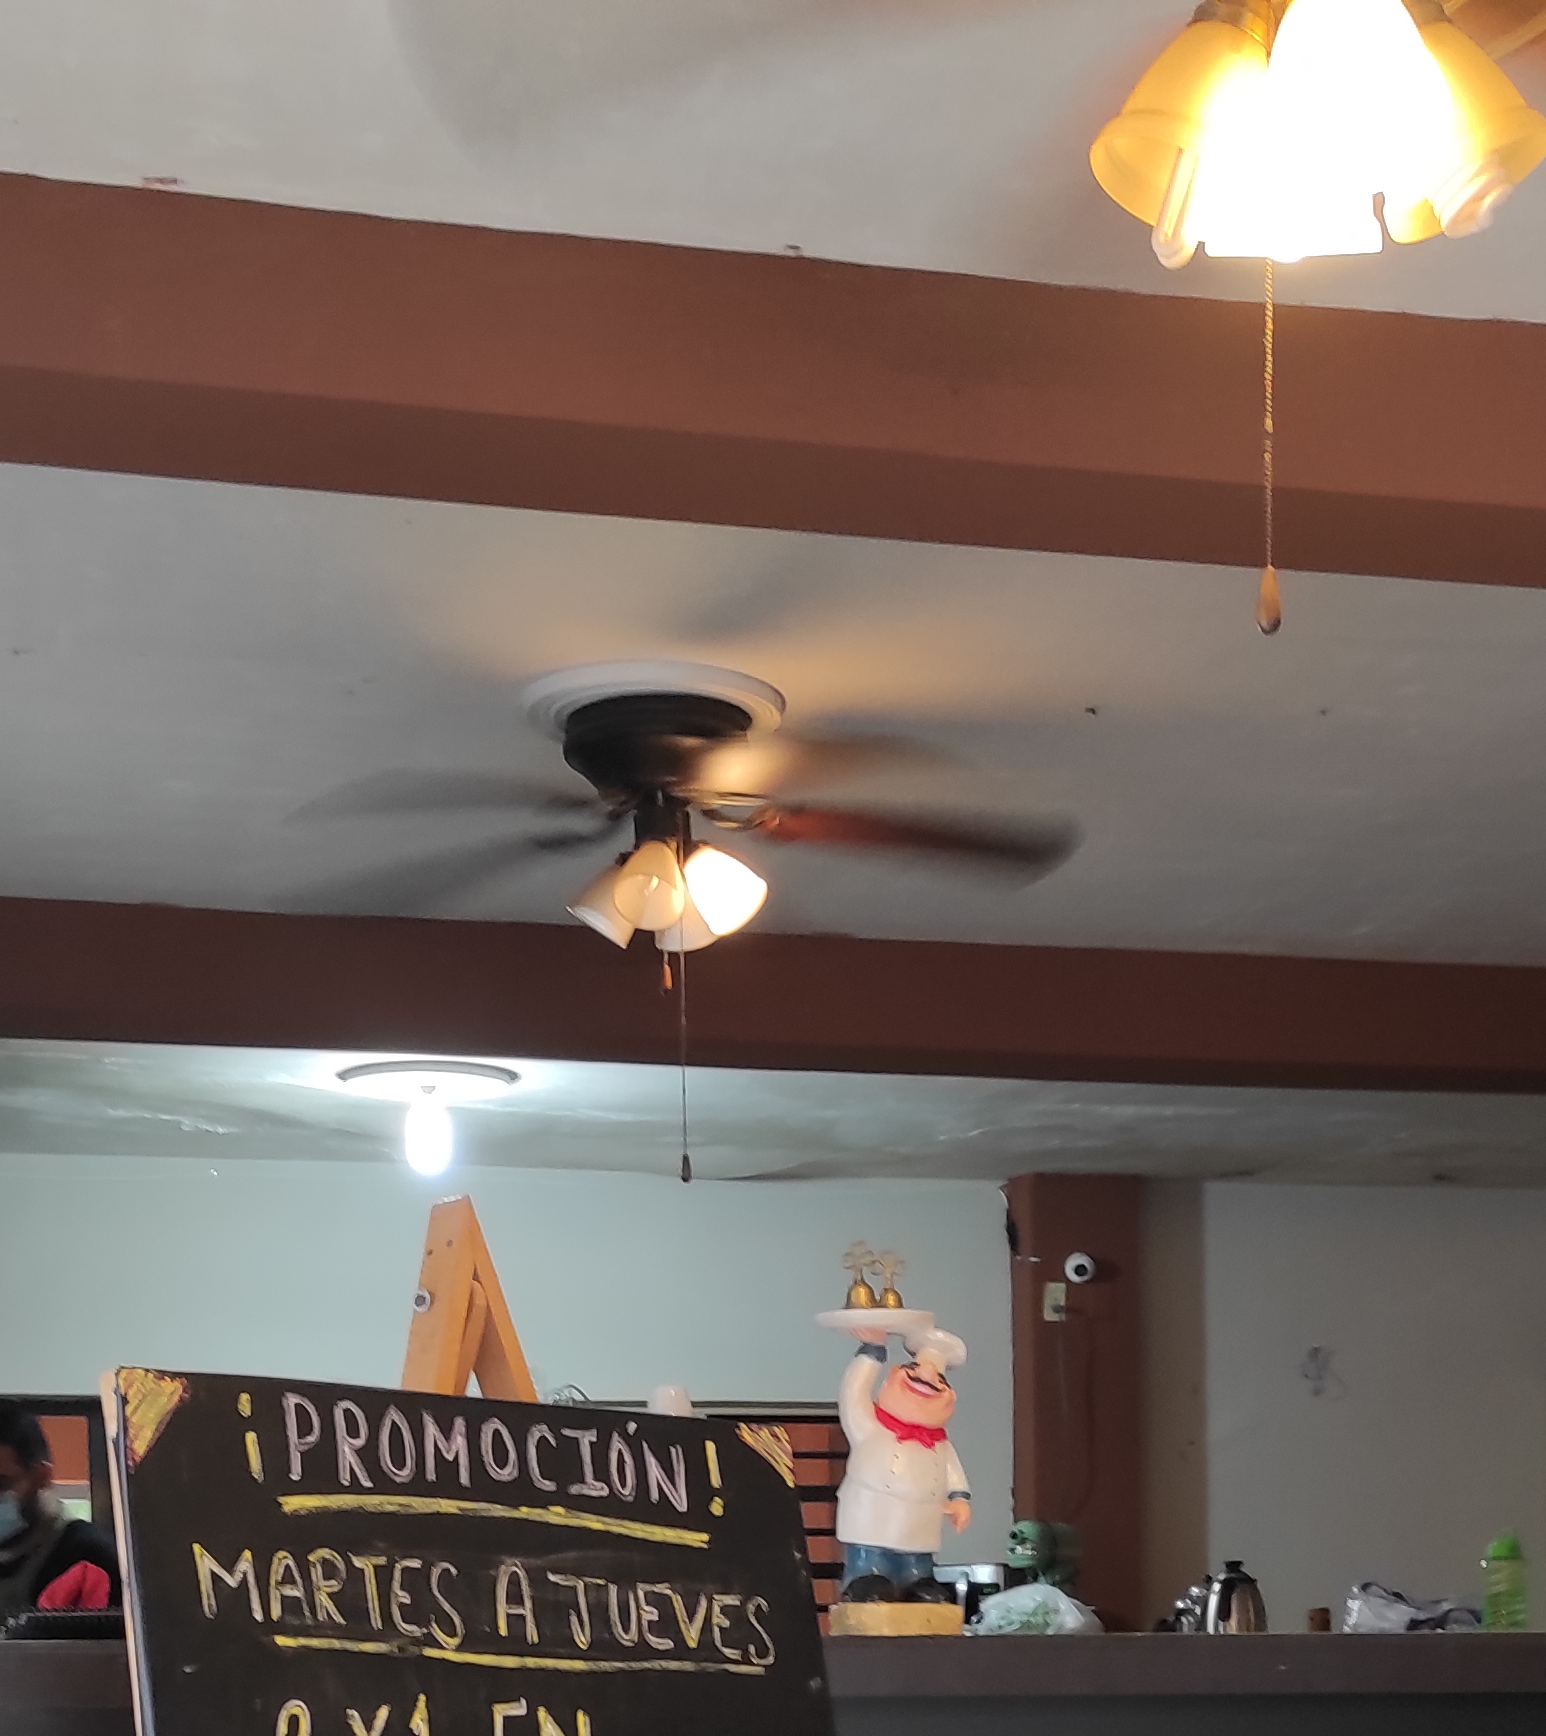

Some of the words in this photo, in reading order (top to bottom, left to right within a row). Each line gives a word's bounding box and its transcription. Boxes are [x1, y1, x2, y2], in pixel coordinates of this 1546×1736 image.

[236, 1391, 725, 1517] ¡PROMOCIÓN!
[191, 1543, 464, 1650] MARTES
[495, 1560, 540, 1645] A
[547, 1569, 776, 1666] JUEVES
